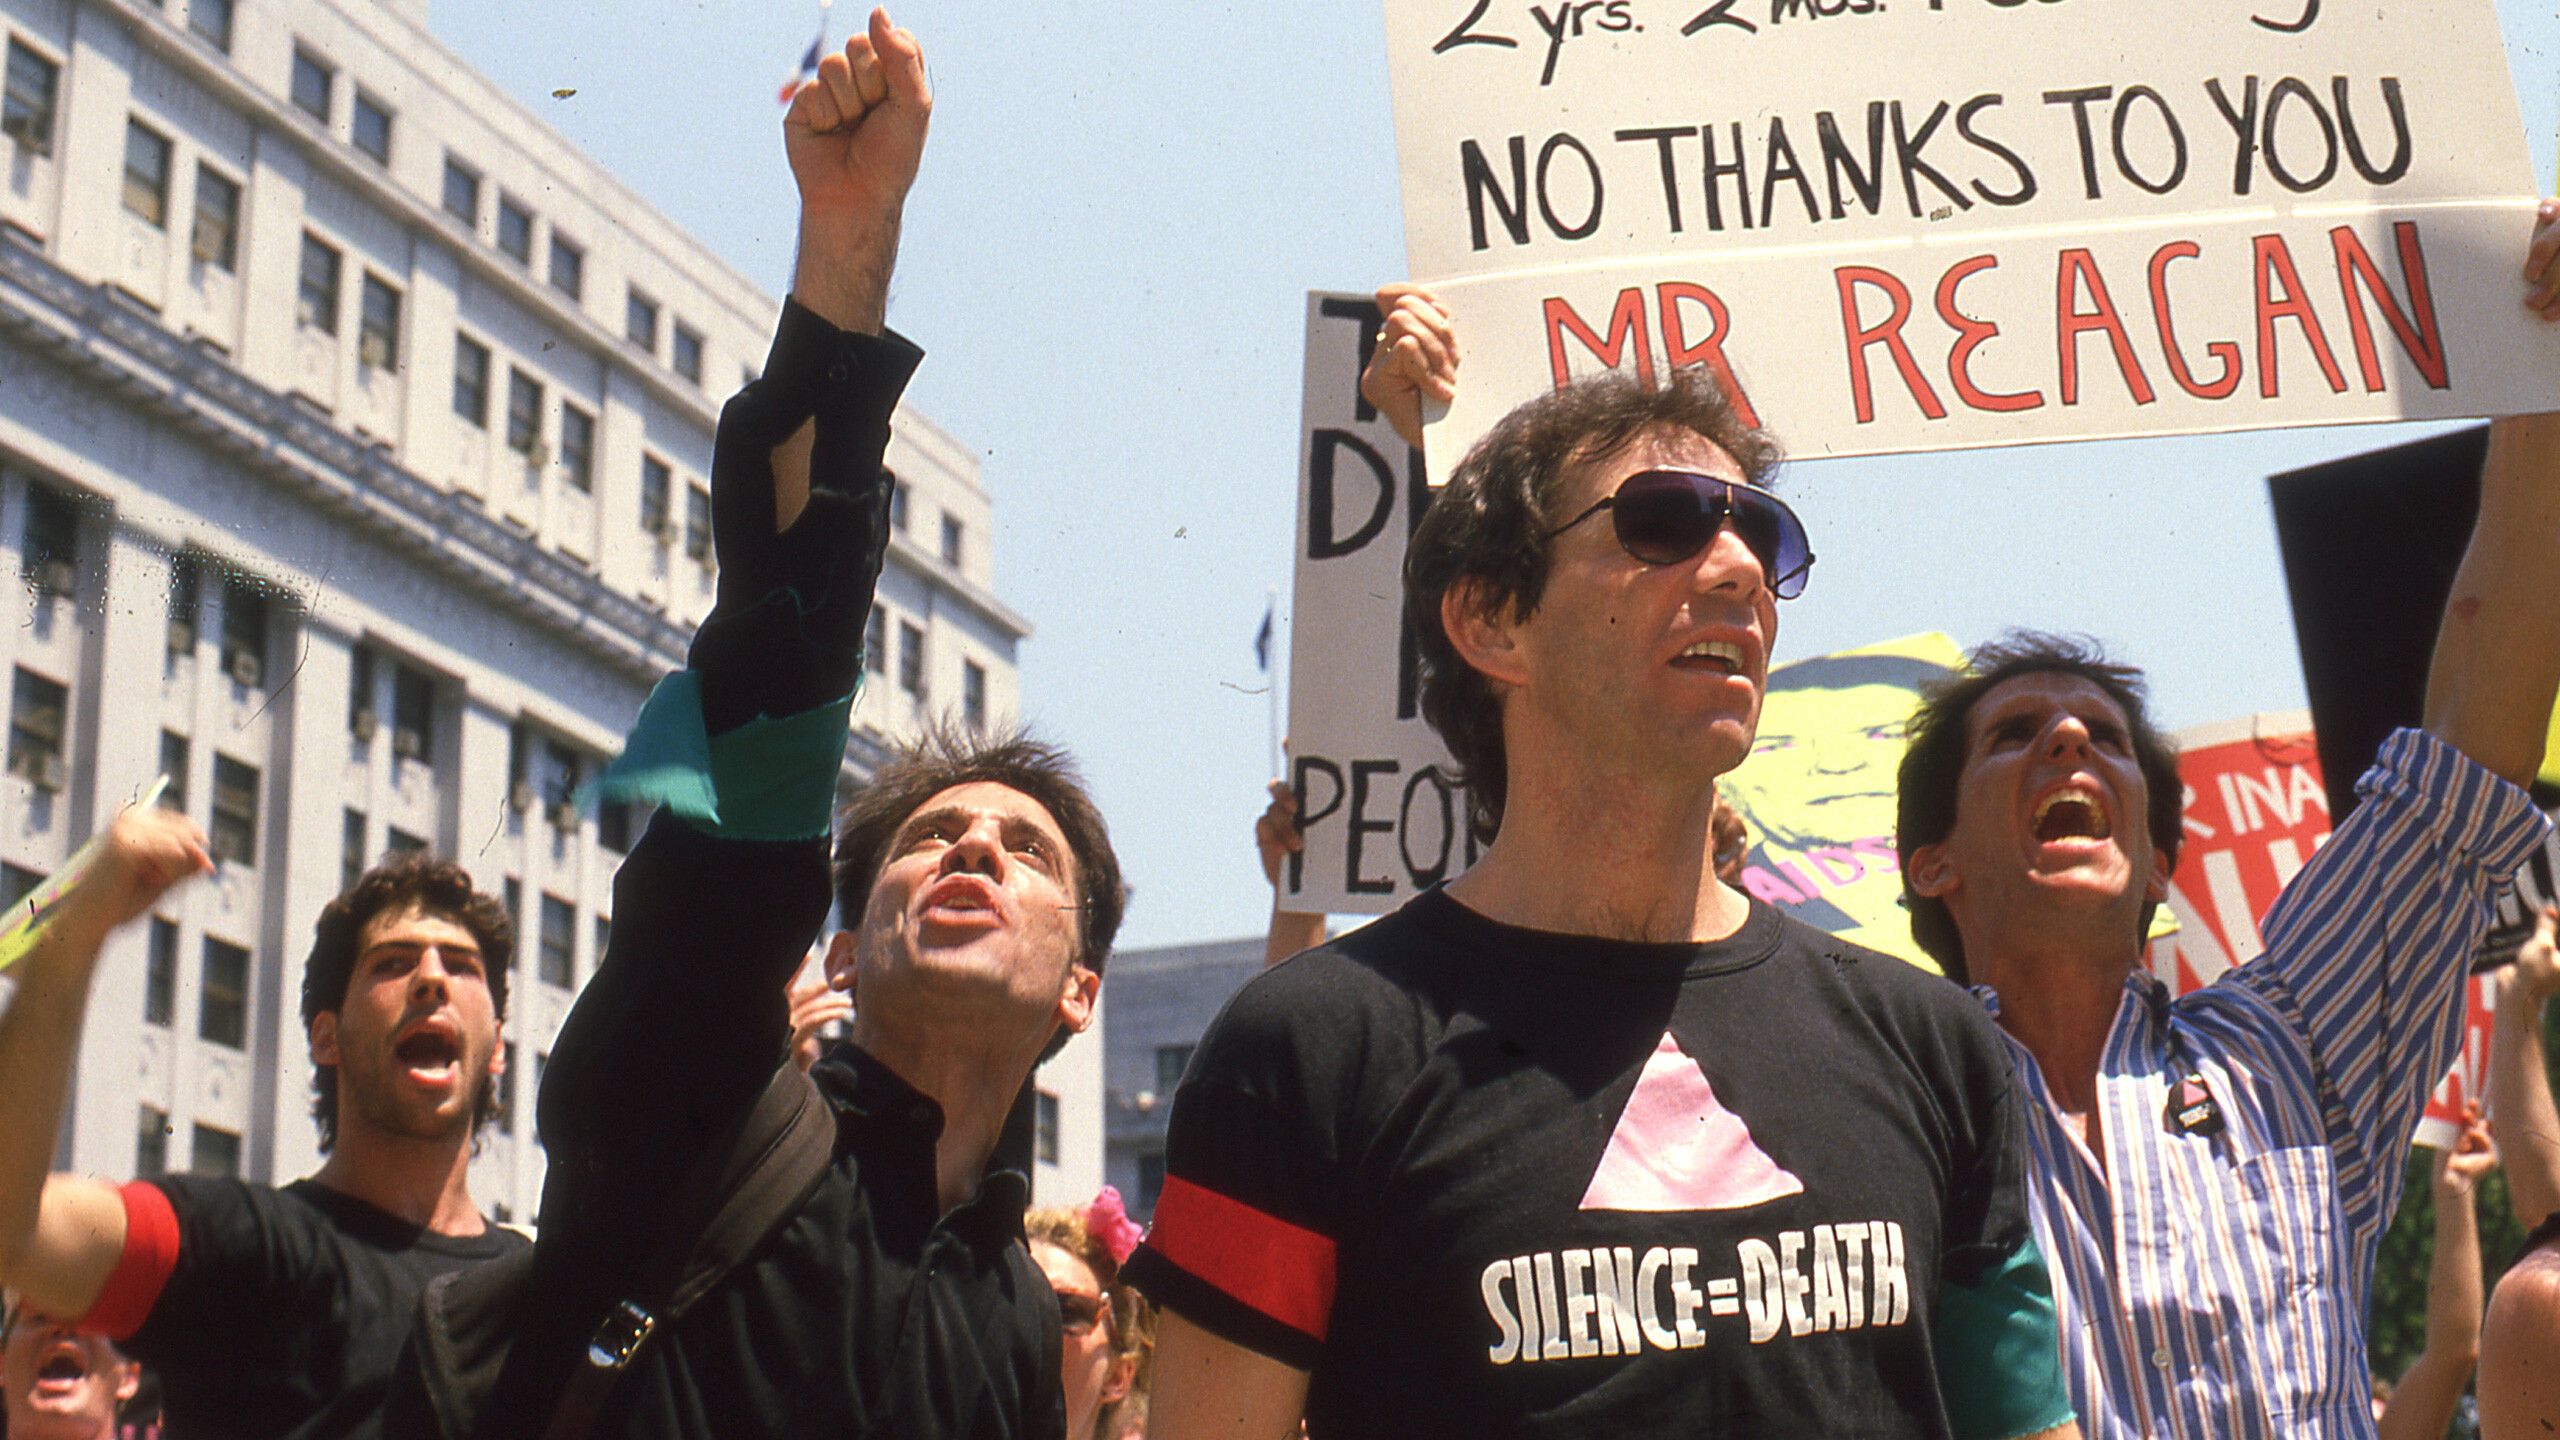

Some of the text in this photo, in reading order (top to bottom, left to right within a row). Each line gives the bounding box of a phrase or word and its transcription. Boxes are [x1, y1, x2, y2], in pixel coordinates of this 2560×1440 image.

[1530, 0, 1644, 86] yrs.
[1461, 76, 2412, 251] NO THANKS TO YOU
[1543, 221, 2450, 430] MR REAGAN
[1481, 1221, 1909, 1365] SILENCE=DEATH
